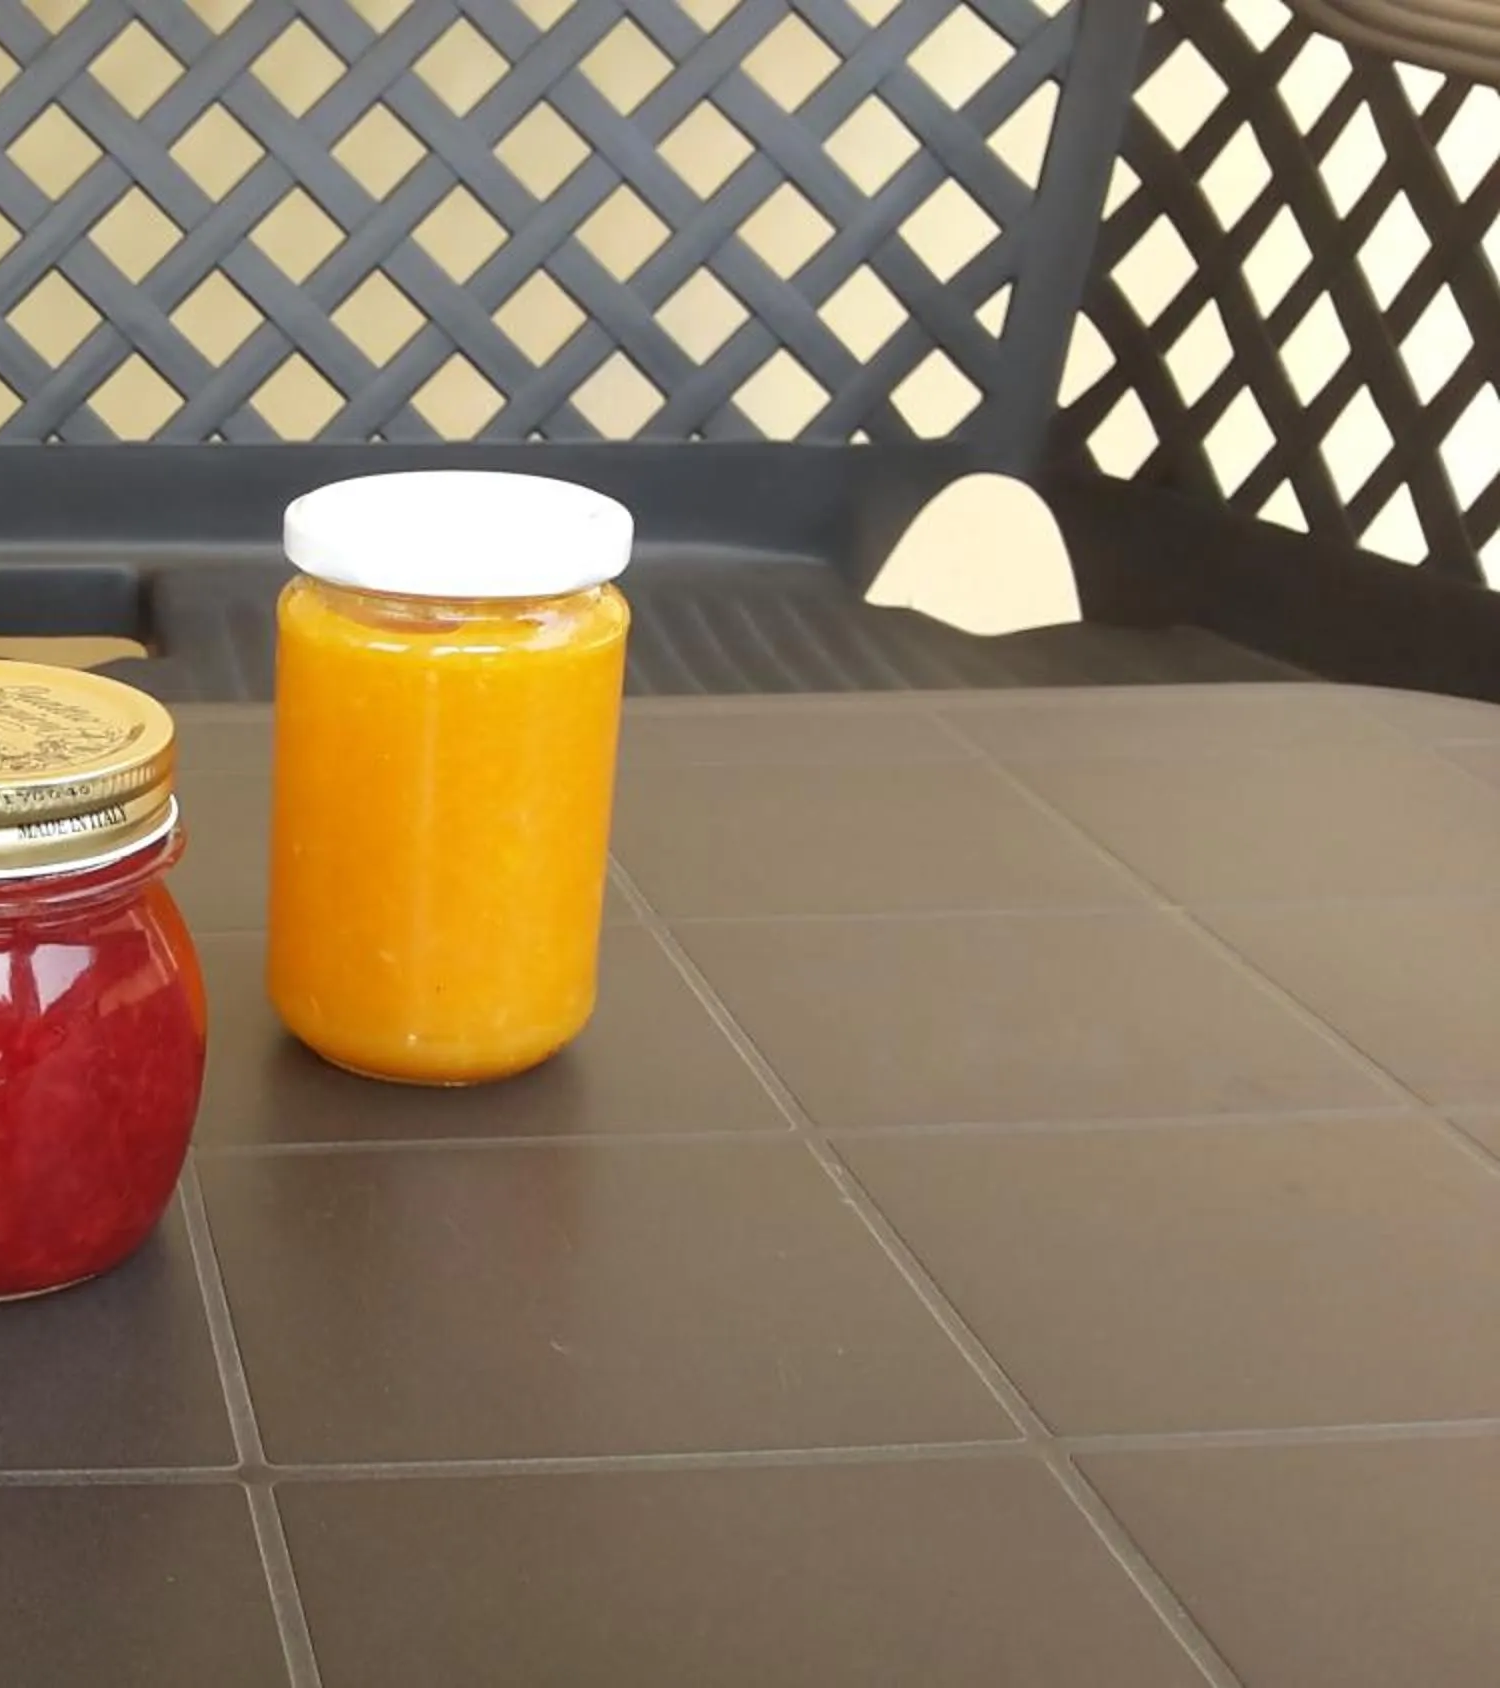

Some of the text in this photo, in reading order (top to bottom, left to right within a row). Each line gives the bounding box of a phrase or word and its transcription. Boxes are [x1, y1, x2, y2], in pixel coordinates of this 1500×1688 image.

[17, 803, 128, 839] MADE IN ITALY
